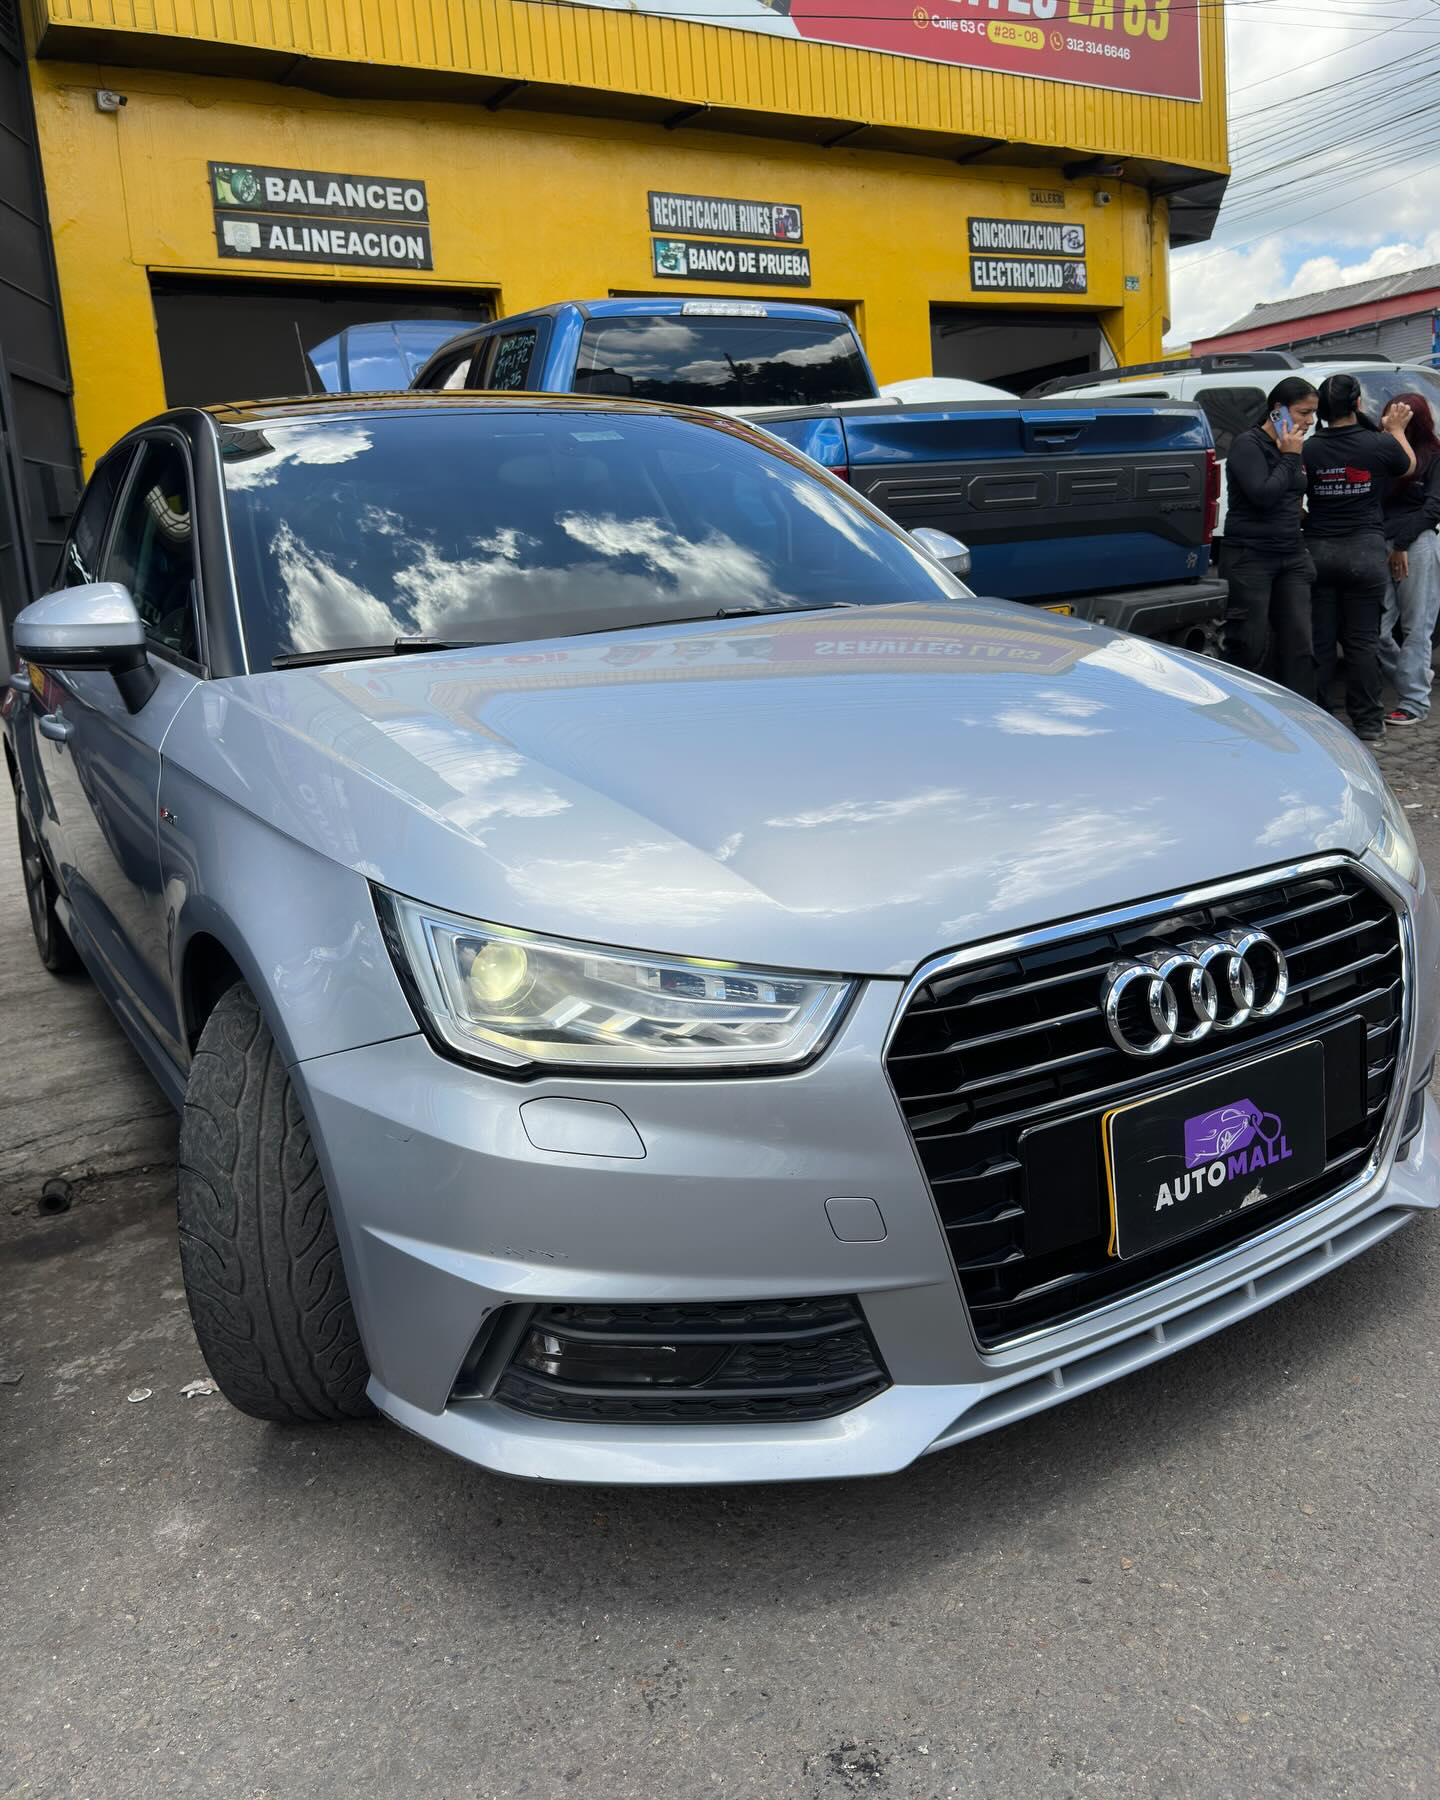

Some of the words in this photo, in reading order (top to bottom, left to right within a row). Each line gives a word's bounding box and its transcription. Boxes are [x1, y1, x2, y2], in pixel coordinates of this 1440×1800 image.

[931, 14, 959, 31] Calle
[960, 19, 976, 33] 63
[977, 22, 986, 36] C
[993, 26, 1016, 40] #28
[1024, 31, 1039, 44] 08
[1123, 0, 1169, 41] 63
[1066, 38, 1085, 52] 312
[1085, 41, 1103, 55] 314
[1104, 44, 1131, 60] 6646
[264, 176, 424, 213] BALANCEO
[653, 196, 737, 232] RECTIFICACION
[738, 204, 771, 235] RINES
[269, 225, 425, 260] ALINEACION
[972, 221, 1062, 251] SINCRONIZACION
[688, 247, 736, 272] BANCO
[738, 251, 757, 274] DE
[759, 253, 810, 276] PRUEBA
[974, 260, 1064, 288] ELECTRICIDAD
[867, 464, 1201, 516] FORD
[1154, 1135, 1293, 1212] AUTOMALL
